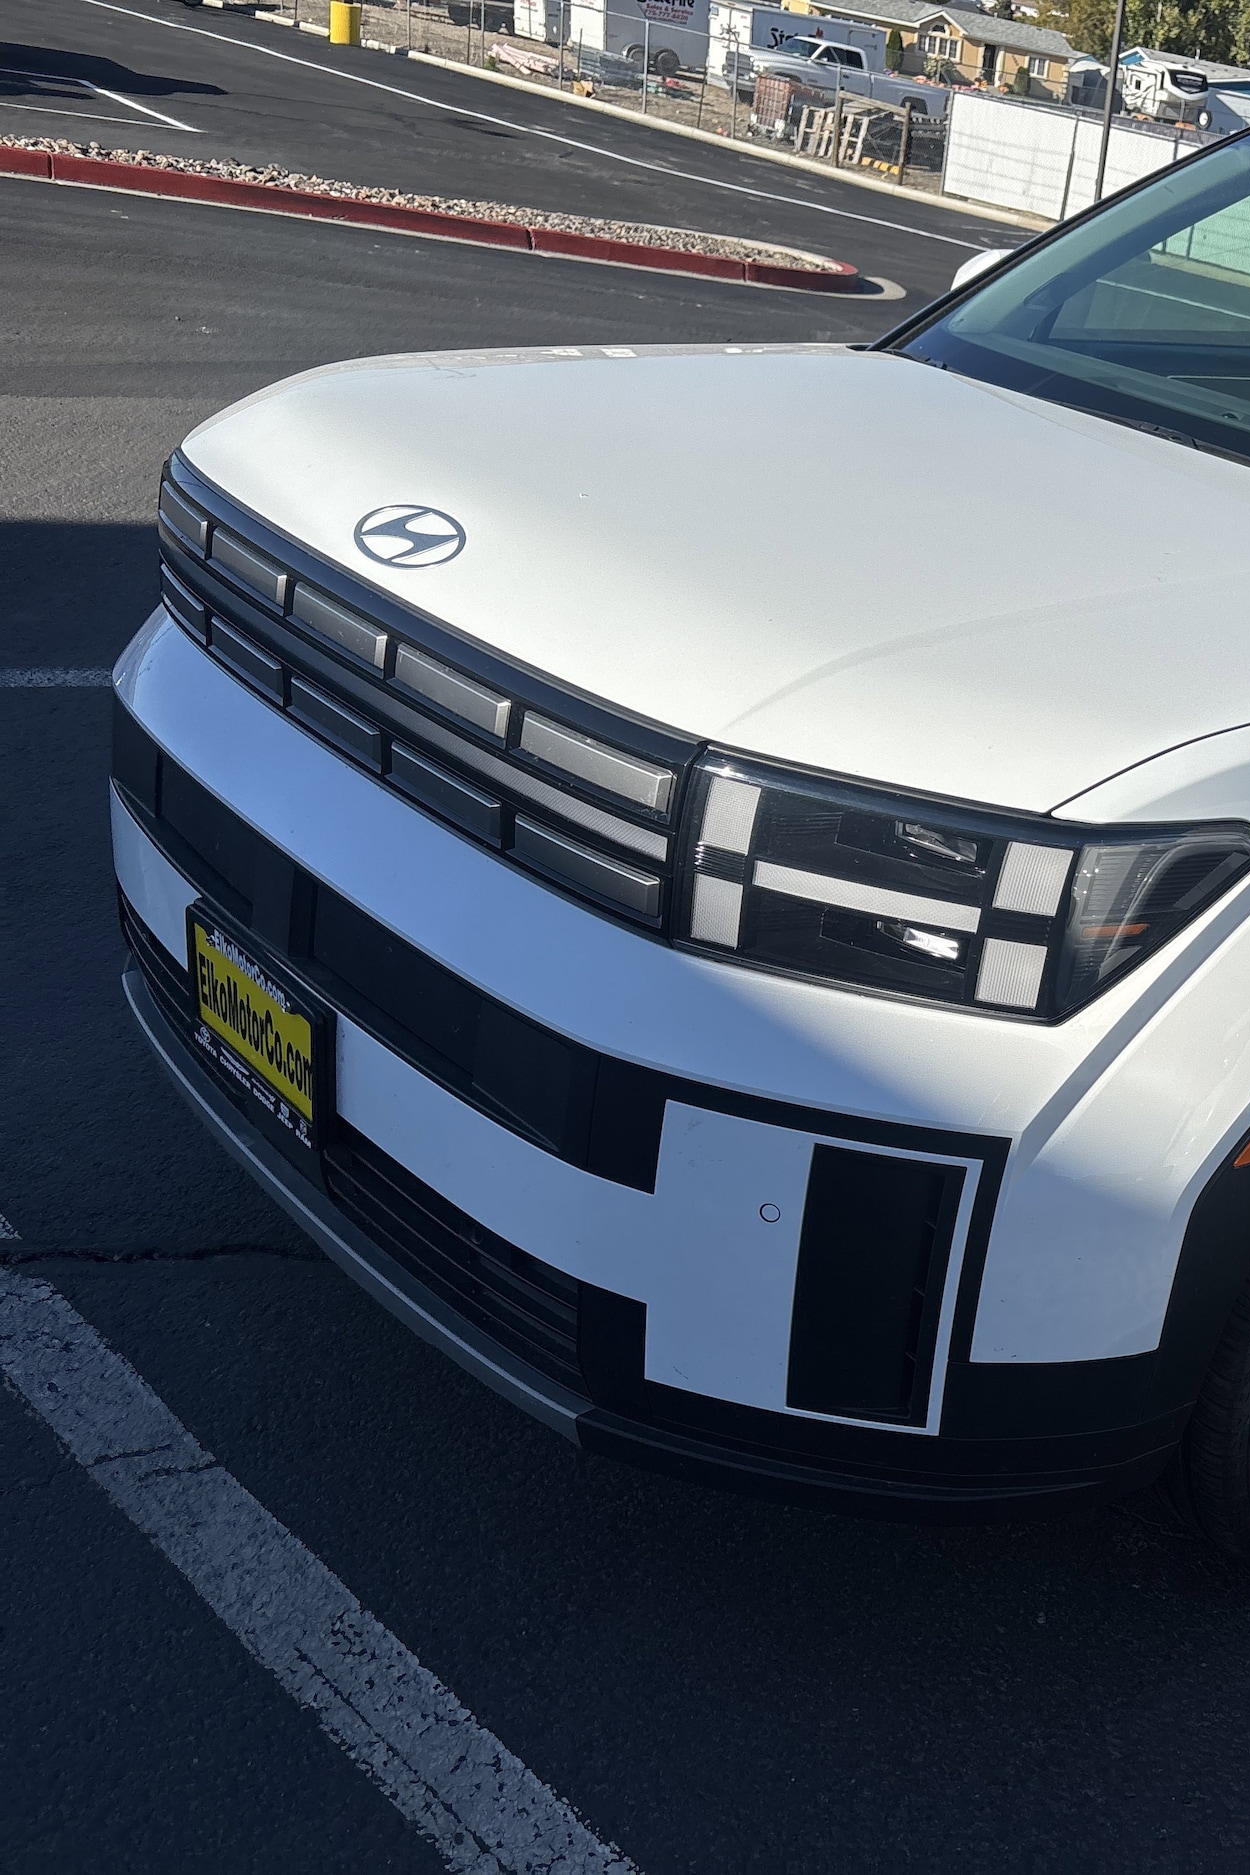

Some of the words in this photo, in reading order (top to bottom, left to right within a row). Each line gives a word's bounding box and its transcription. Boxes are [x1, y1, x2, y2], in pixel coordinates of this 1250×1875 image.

[671, 7, 694, 15] Service
[213, 928, 286, 1008] ElkoMotorCo.com
[194, 1031, 218, 1058] TOYOTA
[219, 1055, 251, 1091] CHRYSLER
[253, 1087, 275, 1114] DODGE
[276, 1112, 294, 1130] JEEP
[295, 1128, 312, 1149] RAM
